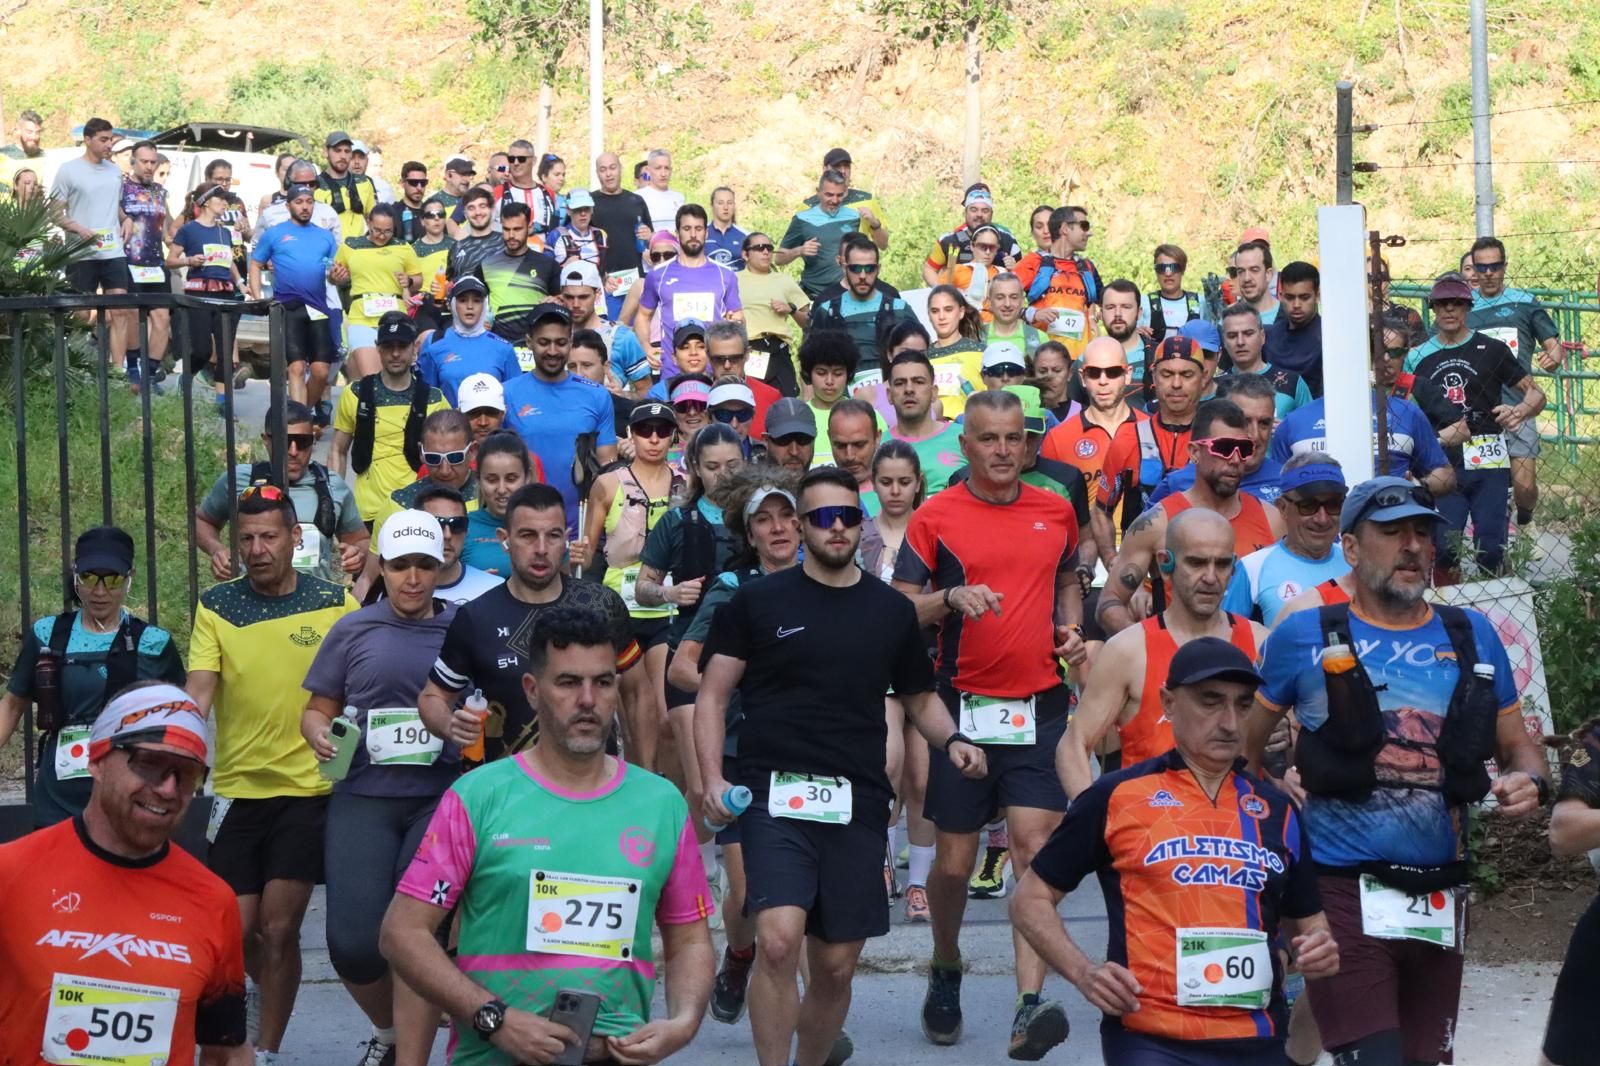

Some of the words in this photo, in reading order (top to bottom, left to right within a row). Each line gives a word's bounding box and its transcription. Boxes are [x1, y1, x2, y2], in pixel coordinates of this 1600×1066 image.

[1065, 317, 1076, 328] 47
[1478, 444, 1501, 458] 236
[392, 526, 436, 541] adidas
[497, 656, 519, 669] 54
[371, 717, 386, 725] 21K
[999, 708, 1010, 724] 2
[393, 726, 431, 745] 190
[806, 785, 832, 803] 30
[1144, 836, 1285, 874] ATLETISMO
[1171, 864, 1268, 891] CAMAS
[536, 883, 558, 895] 10K
[1406, 891, 1432, 917] 21
[150, 912, 182, 923] GSPORT
[565, 899, 623, 930] 275
[1183, 940, 1205, 951] 21K
[1225, 955, 1255, 980] 60
[58, 988, 85, 1003] 10K
[87, 1007, 156, 1043] 505
